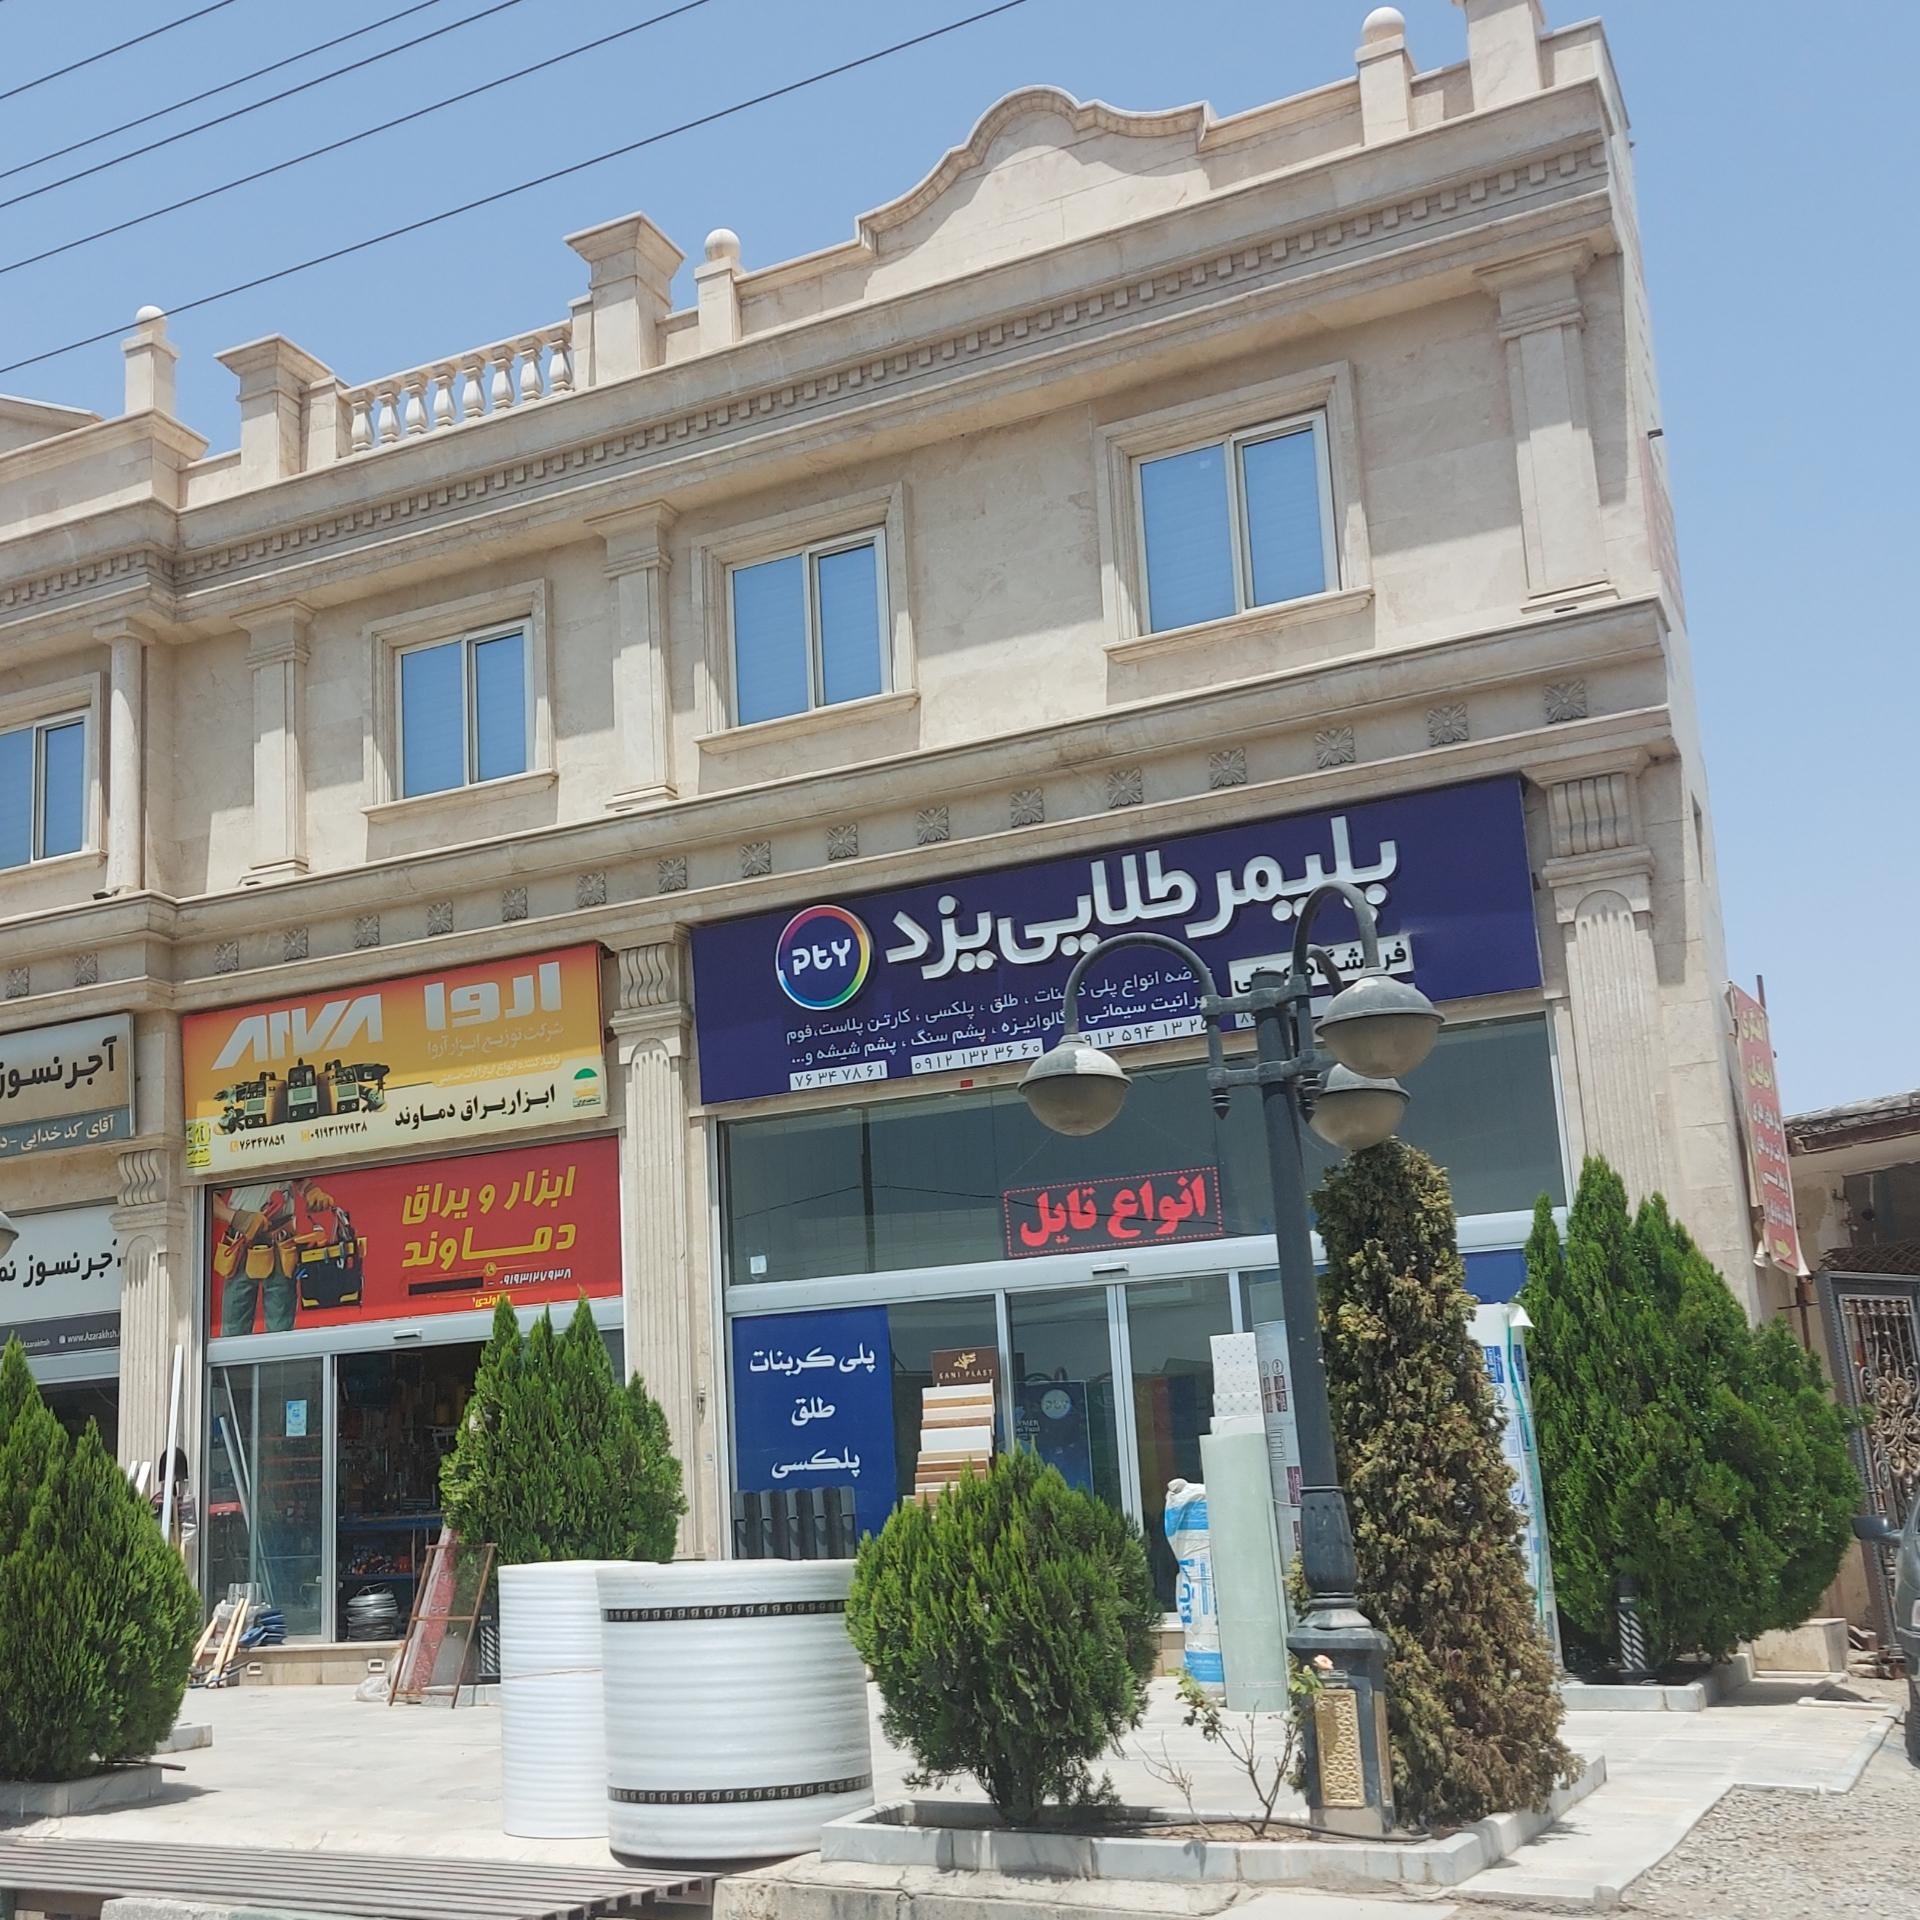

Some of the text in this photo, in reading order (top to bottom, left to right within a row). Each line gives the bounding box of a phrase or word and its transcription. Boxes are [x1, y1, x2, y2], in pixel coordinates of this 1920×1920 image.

[886, 815, 1398, 979] پلیمر طلایی یزد
[1090, 979, 1117, 998] پلی
[1121, 971, 1160, 997] انواع
[925, 1001, 975, 1024] پلکسی
[990, 993, 1018, 1014] طلق
[1085, 1003, 1147, 1024] سیمانی
[524, 1022, 564, 1042] شرکت
[867, 1008, 911, 1032] کارتن
[482, 1029, 523, 1053] توزیع
[911, 1029, 948, 1047] سنگ
[952, 1024, 986, 1045] پشم
[1084, 1031, 1115, 1047] ۹۱۲
[816, 1042, 861, 1062] شیشه
[864, 1037, 896, 1057] پشم
[914, 1055, 952, 1070] ۰۹۱۲
[961, 1049, 989, 1065] ۱۳۲
[994, 1045, 1014, 1060] ۳۶
[795, 1064, 884, 1087] ۷۶ ۳۴ ۷۸ ۶۱
[86, 1114, 115, 1139] آقای
[395, 1101, 455, 1130] دماوند
[402, 1165, 576, 1225] ابزار و یراق
[1020, 1174, 1207, 1248] انواع تایل
[401, 1223, 577, 1271] دماوند
[67, 1329, 119, 1343] www.Azarakhsh.
[750, 1342, 876, 1377] پلی کربنات
[791, 1397, 836, 1427] طلق
[771, 1447, 861, 1480] پلکسی
